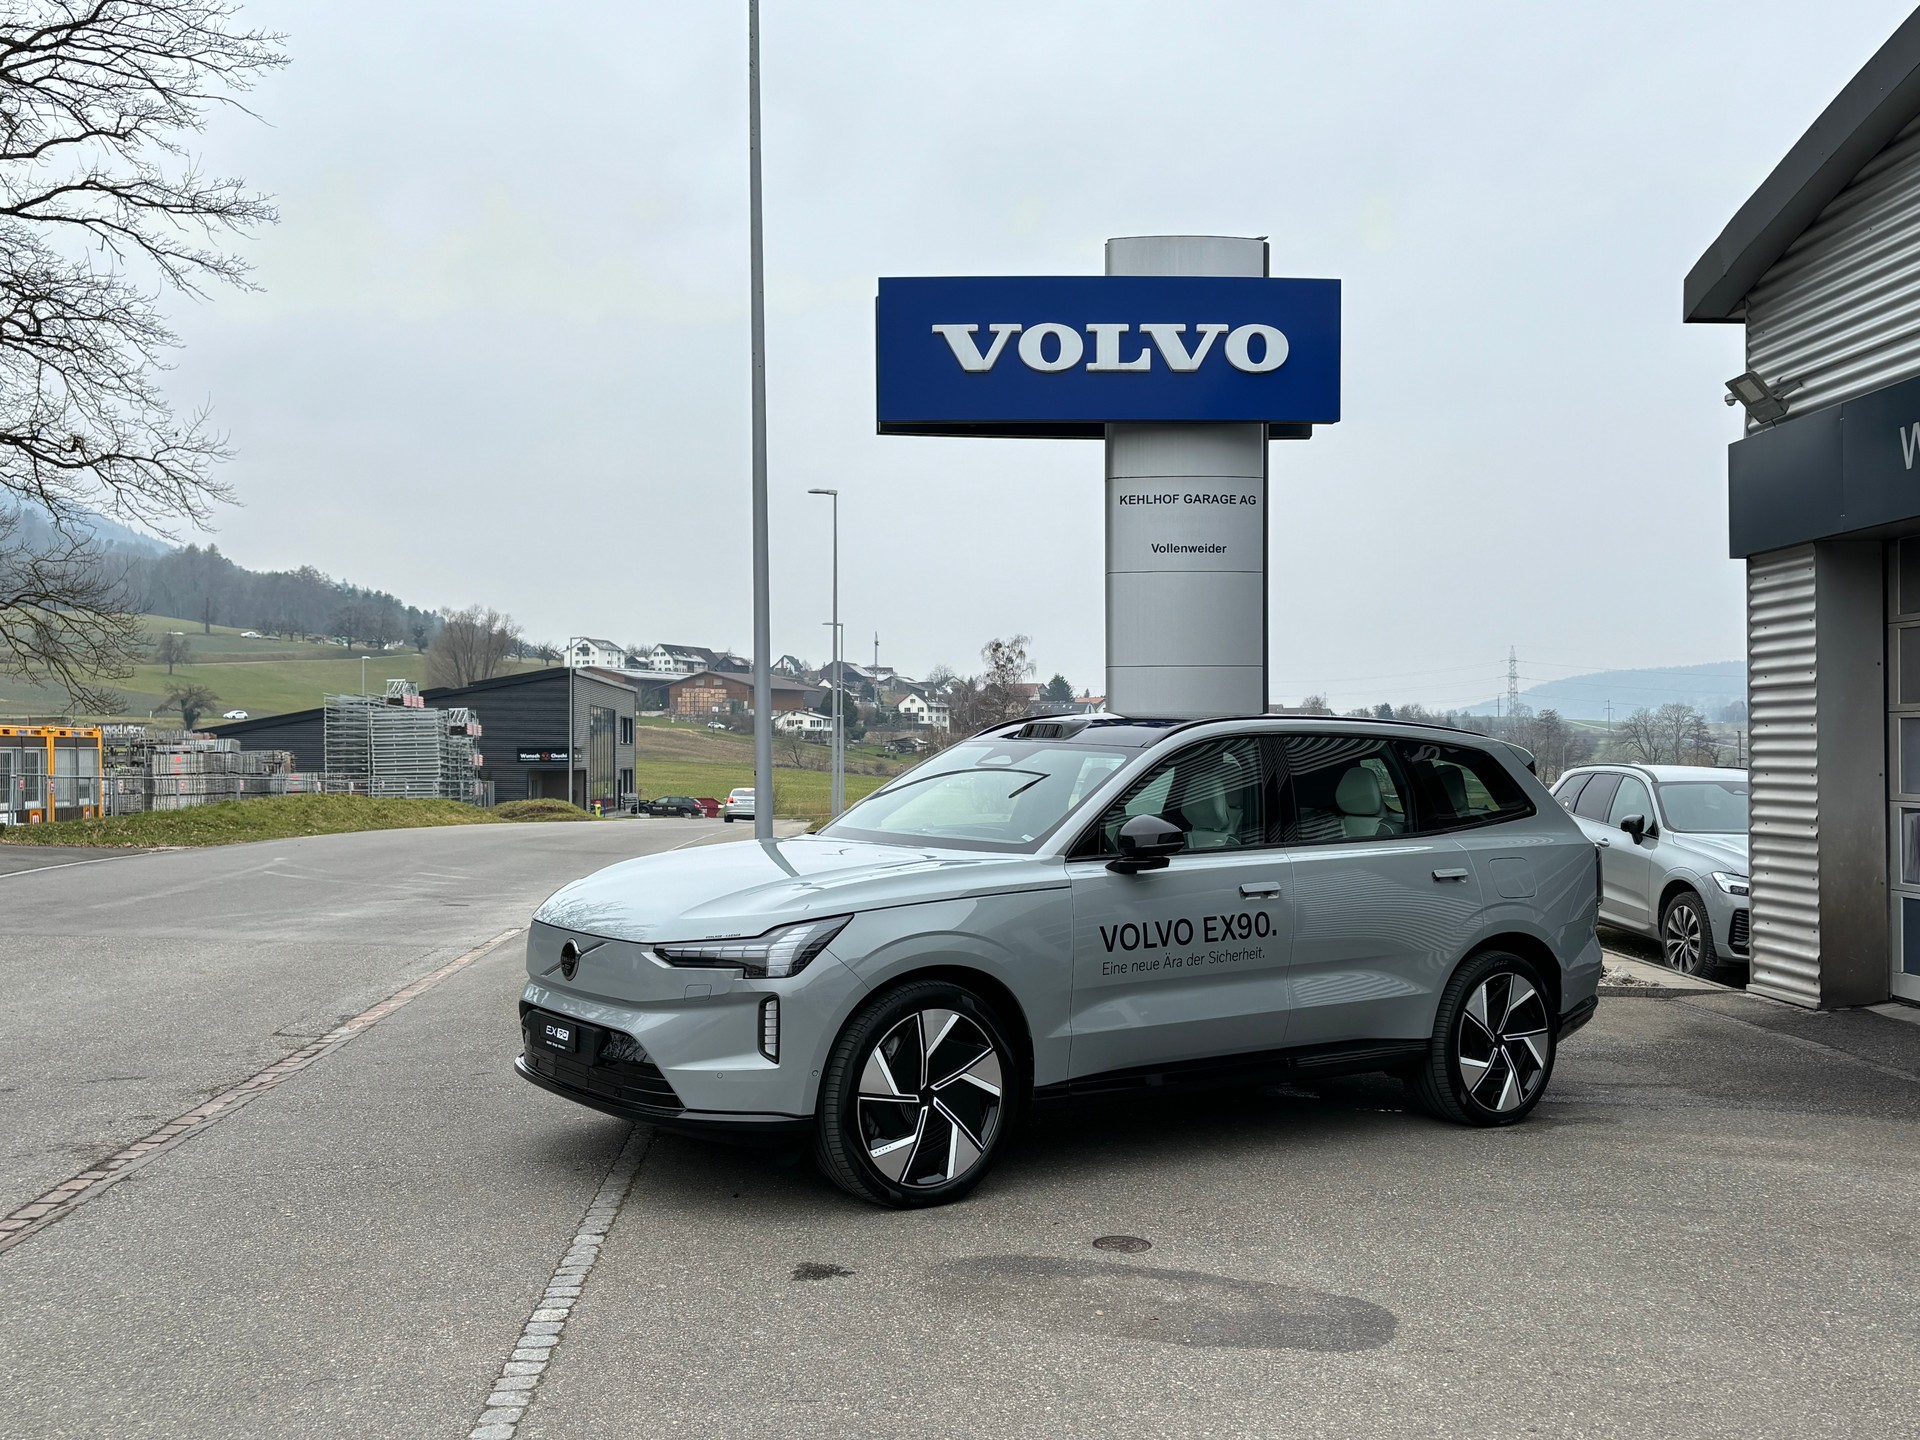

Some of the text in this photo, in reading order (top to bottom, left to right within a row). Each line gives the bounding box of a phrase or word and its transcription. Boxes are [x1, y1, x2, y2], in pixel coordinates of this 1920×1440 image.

[931, 323, 1289, 373] VOLVO
[1119, 494, 1257, 505] KEHLHOF GARAGE AG
[1151, 543, 1228, 554] Vollenweider
[1099, 911, 1277, 952] VOLVO EX90.
[1102, 946, 1265, 976] Eine neue Ära der Sicherheit.
